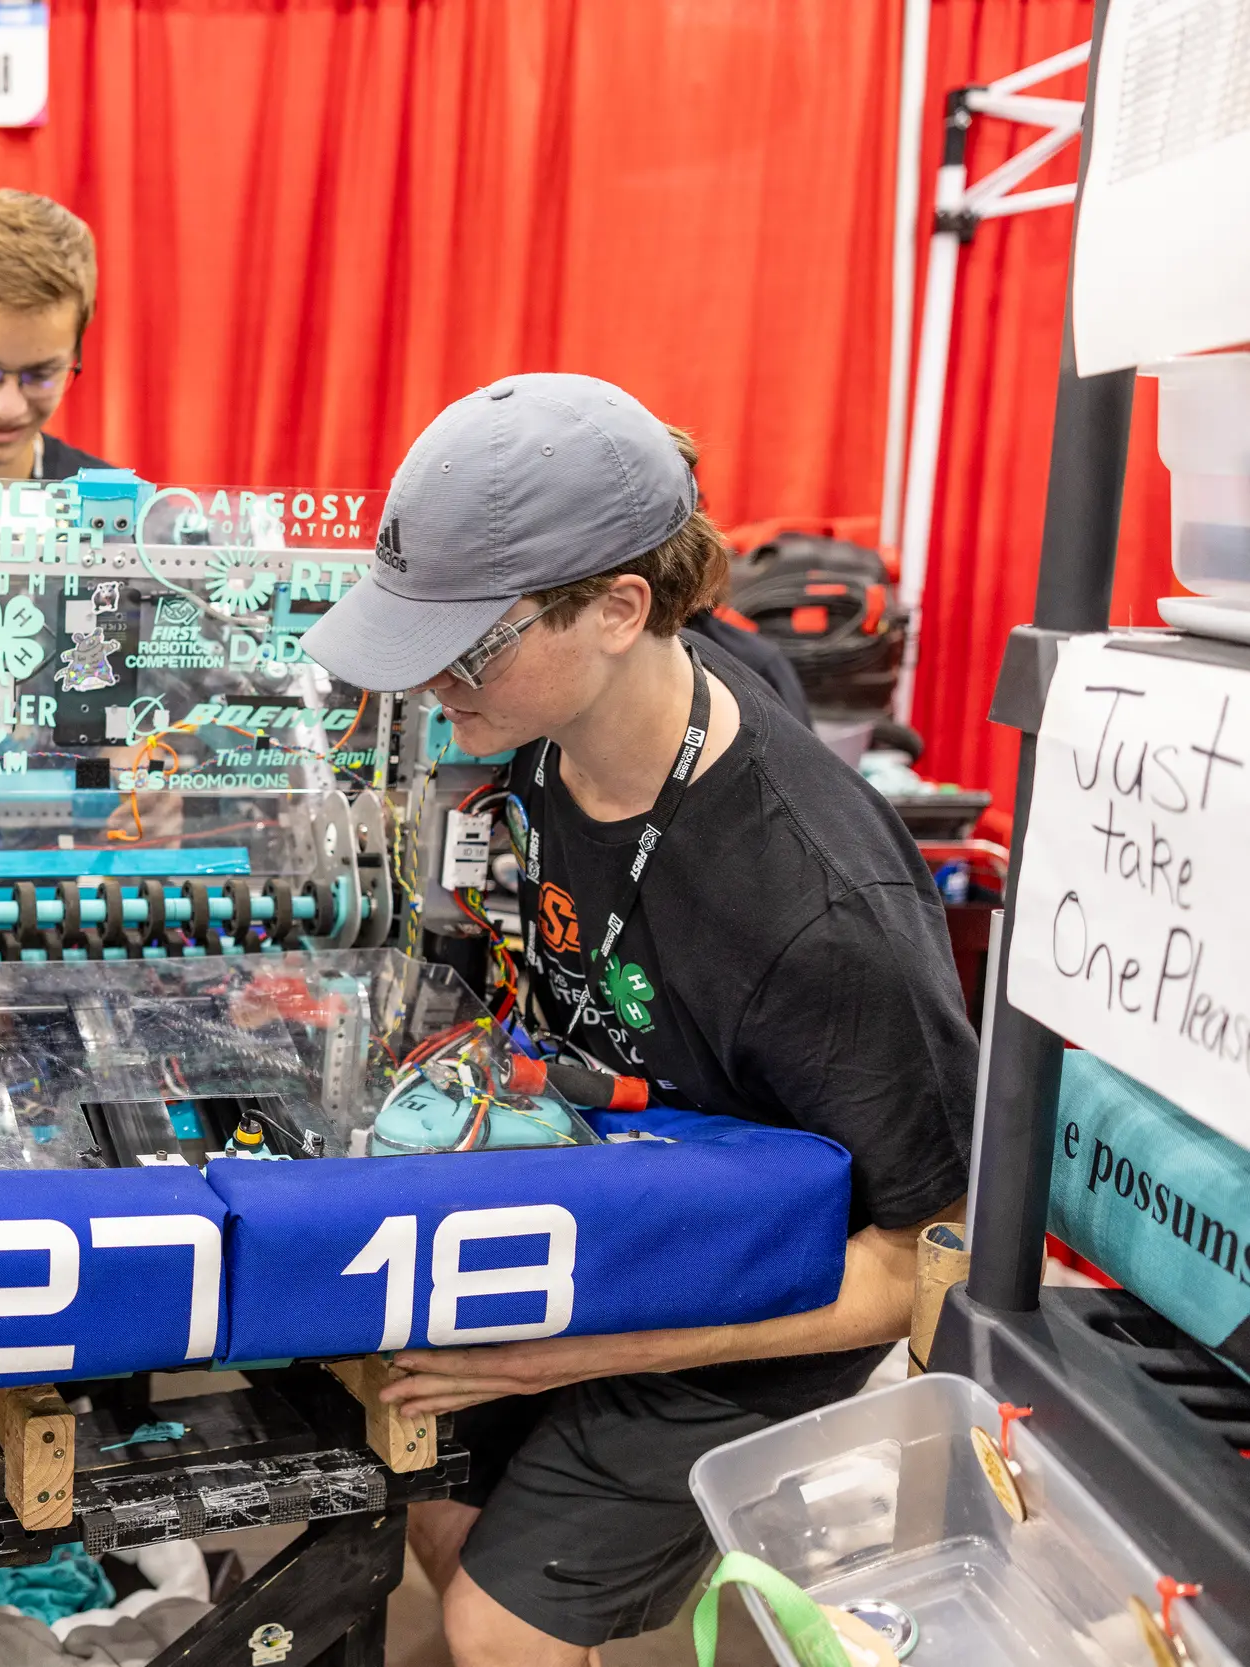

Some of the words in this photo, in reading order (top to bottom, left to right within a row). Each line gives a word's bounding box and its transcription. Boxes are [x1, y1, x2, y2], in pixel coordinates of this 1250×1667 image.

[209, 490, 365, 521] ARGOSY
[208, 520, 360, 538] FOUNDATION
[138, 641, 212, 654] ROBOTICS
[151, 626, 202, 640] FIRST
[125, 655, 224, 668] COMPETITION
[182, 704, 360, 730] BOEING
[216, 749, 249, 766] The
[678, 747, 697, 780] MOUSER
[1072, 686, 1244, 812] Just
[169, 774, 289, 790] PROMOTIONS
[528, 827, 541, 860] FIRST
[1091, 799, 1193, 910] take
[630, 848, 648, 882] FIRST
[1154, 927, 1250, 1076] Pleas
[341, 1204, 578, 1351] 18
